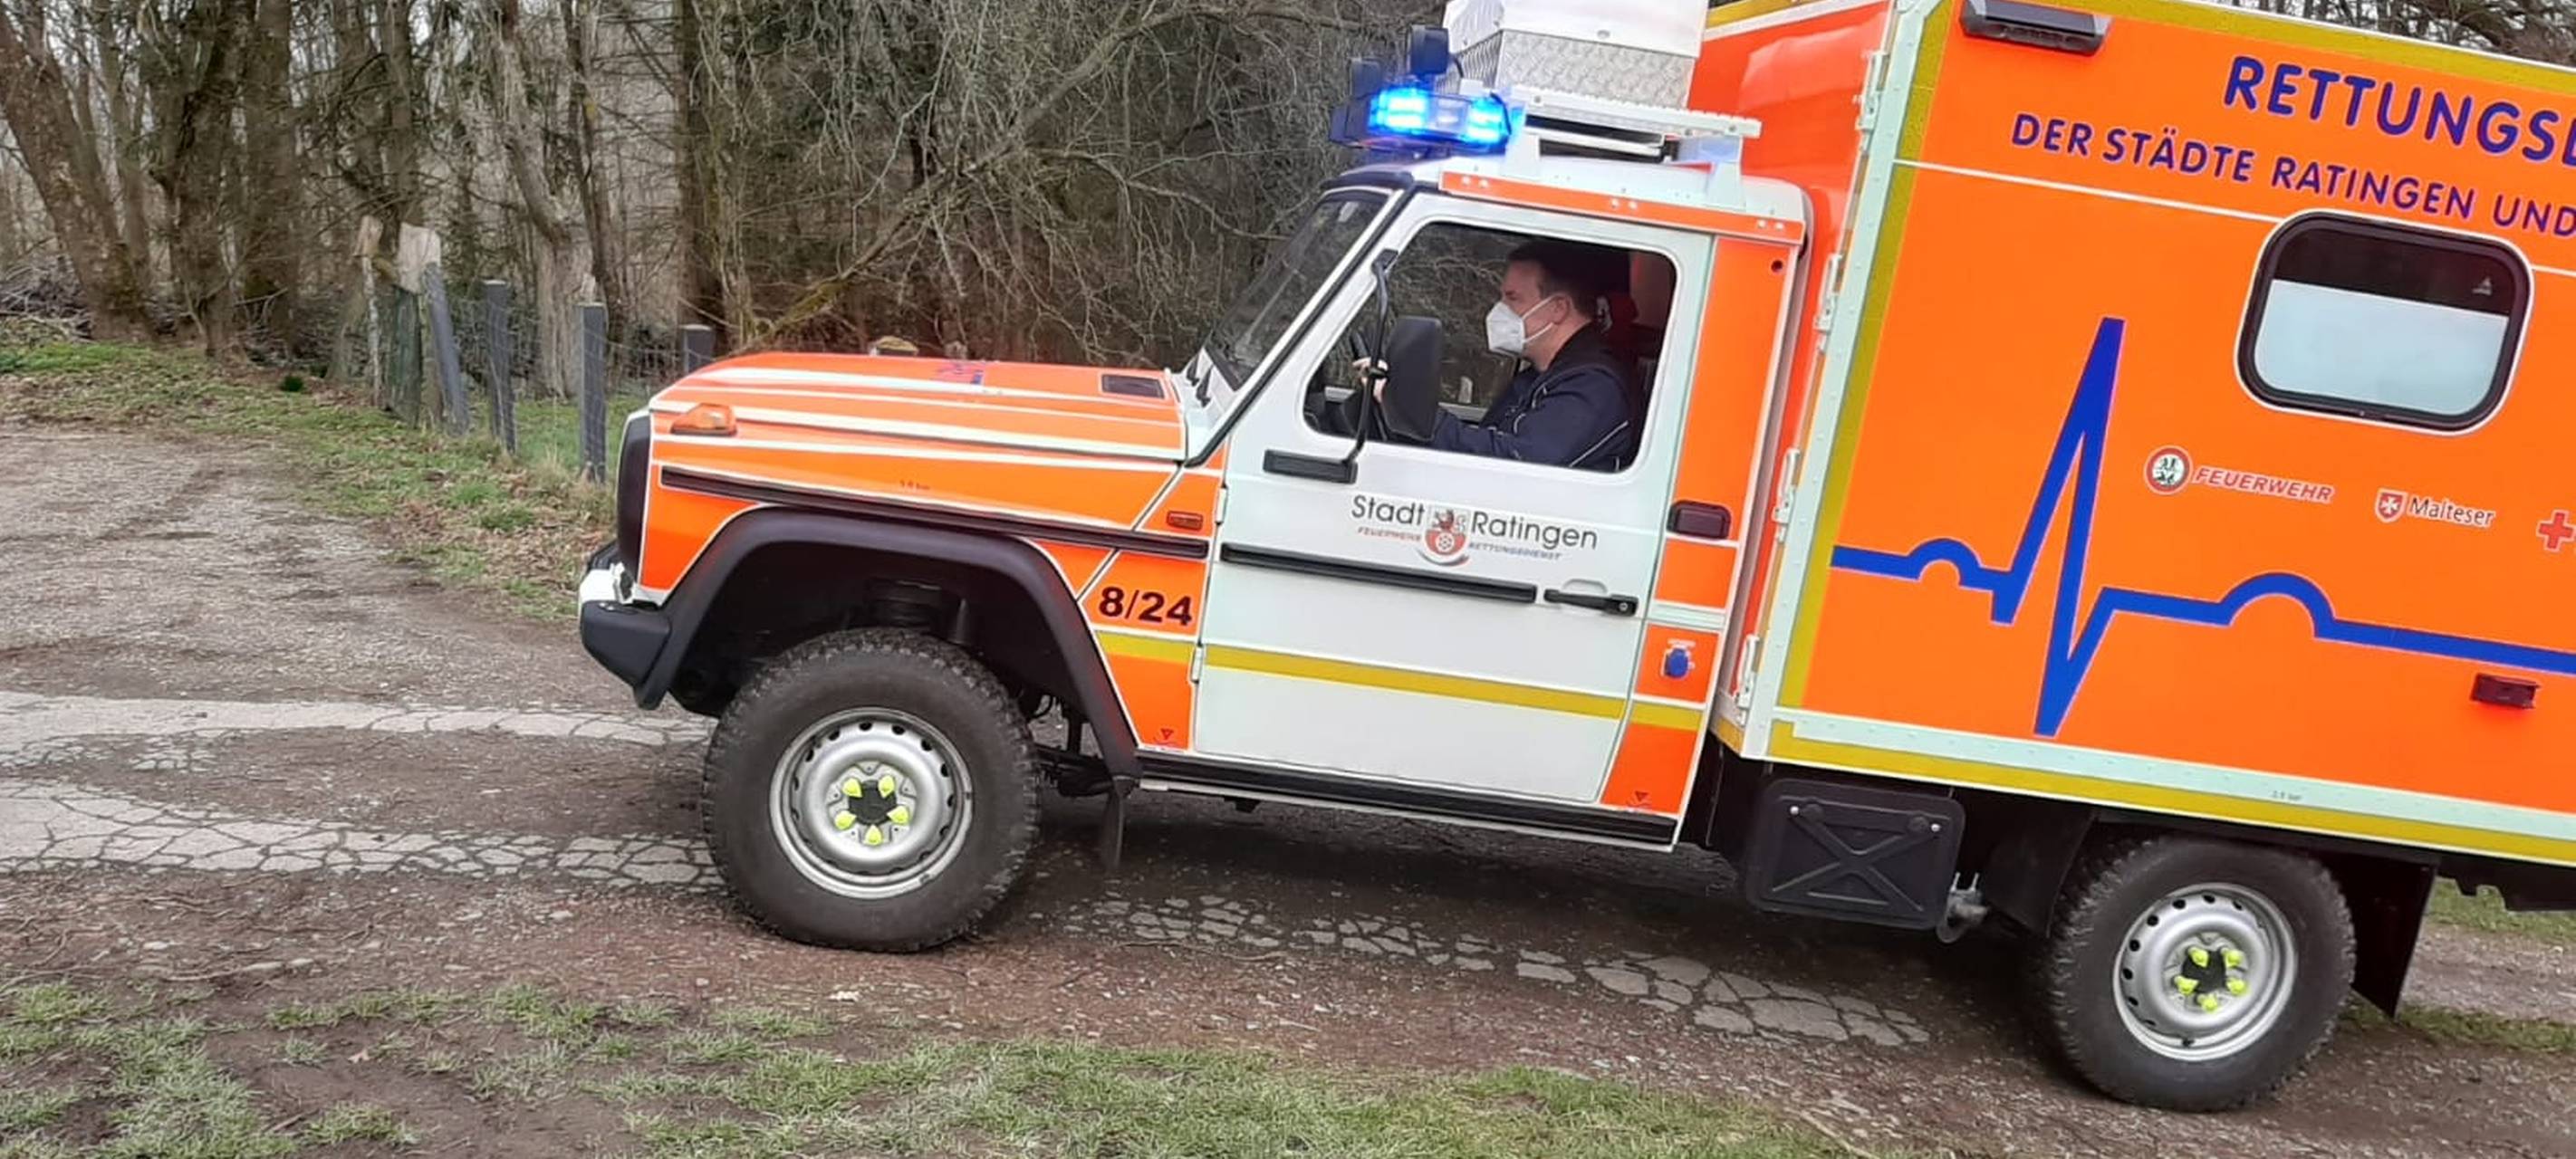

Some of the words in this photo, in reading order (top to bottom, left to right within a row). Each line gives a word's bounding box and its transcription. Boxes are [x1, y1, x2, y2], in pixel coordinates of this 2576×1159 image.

[2012, 113, 2093, 157] DER
[2103, 128, 2255, 183] STÄDTE
[2271, 156, 2475, 219] RATINGEN
[2493, 195, 2576, 236] UND
[2196, 467, 2332, 500] FEUERWEHR
[1351, 494, 1425, 525] Stadt
[1471, 511, 1598, 551] Ratingen
[2409, 497, 2494, 525] Malteser
[1098, 585, 1193, 627] 8/24
